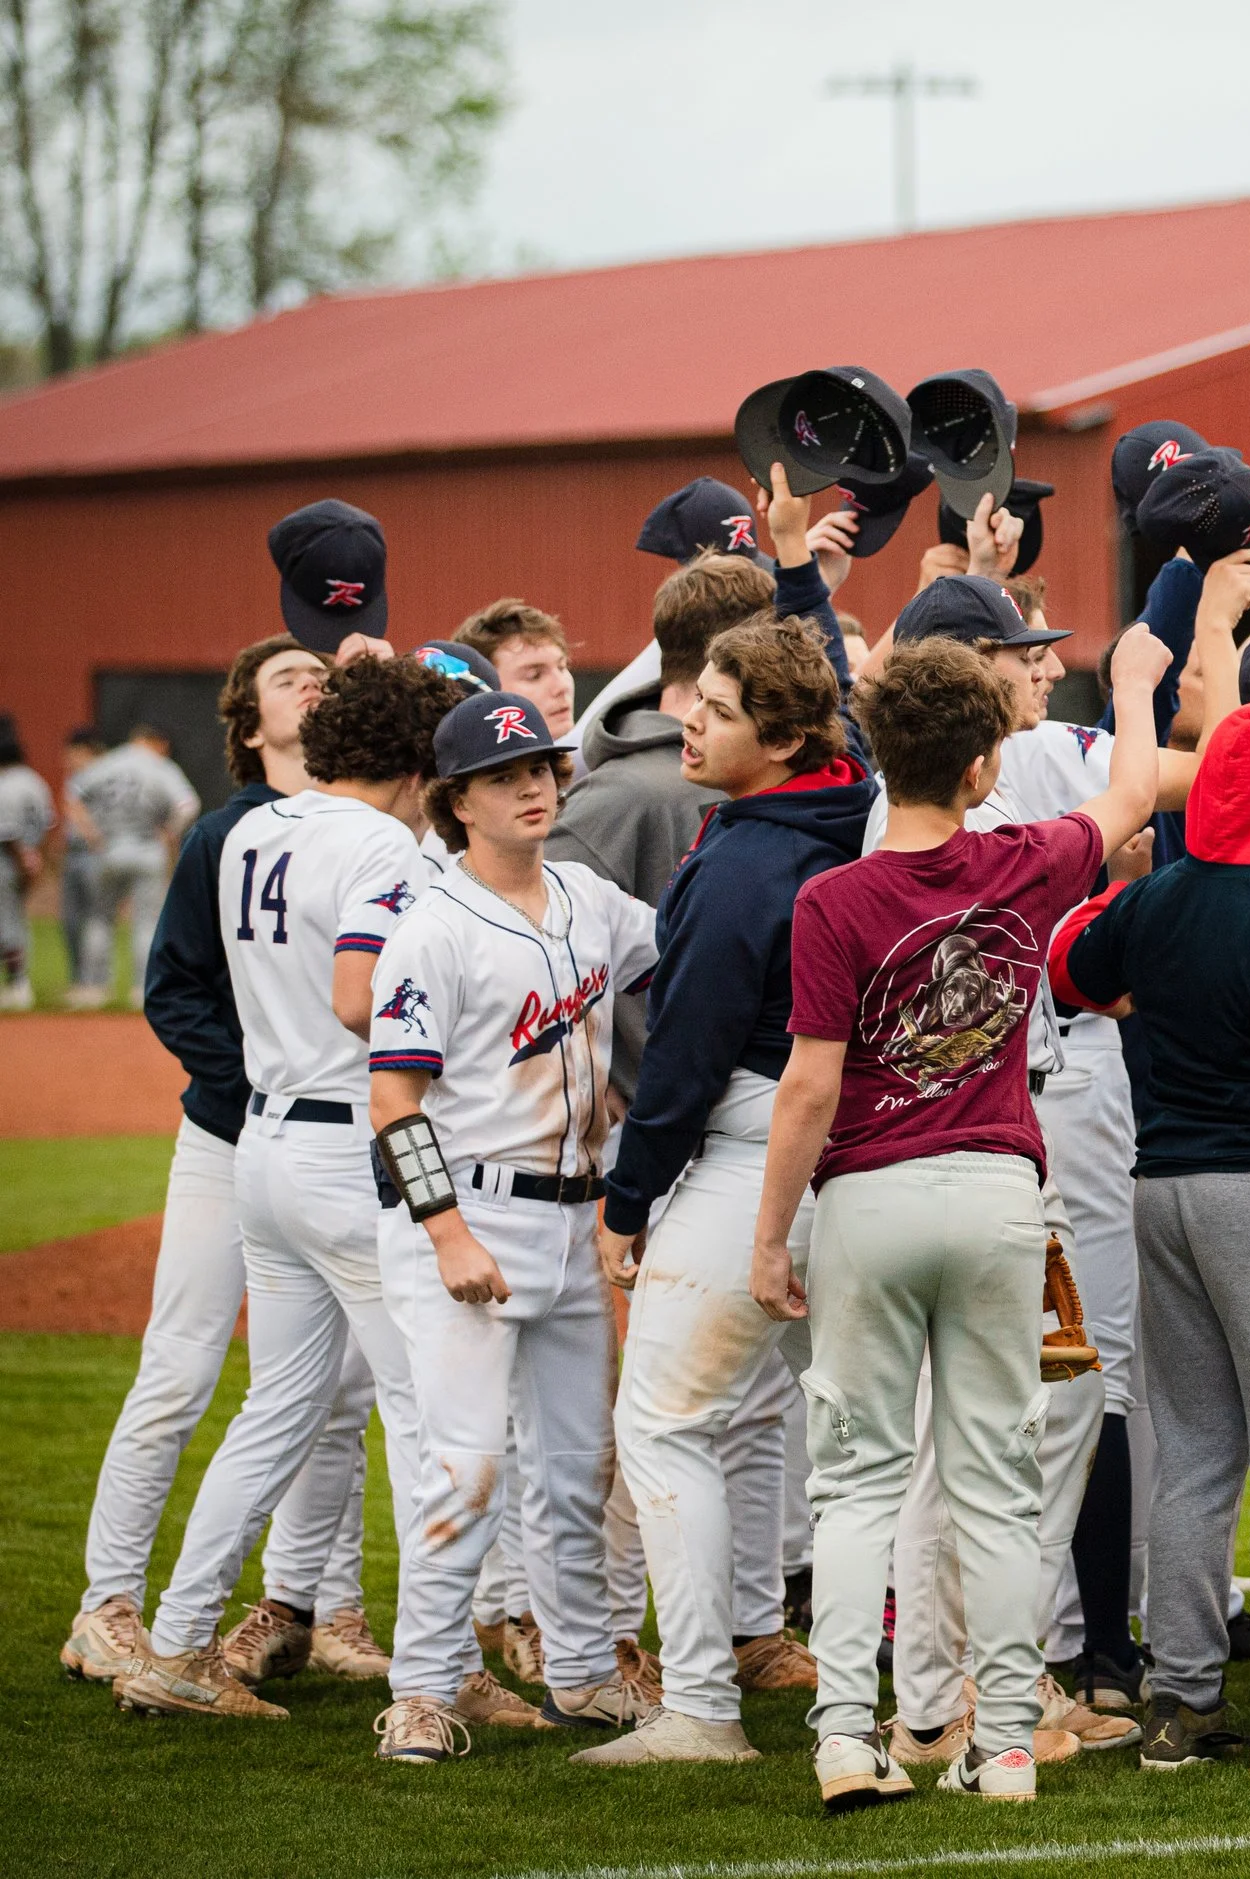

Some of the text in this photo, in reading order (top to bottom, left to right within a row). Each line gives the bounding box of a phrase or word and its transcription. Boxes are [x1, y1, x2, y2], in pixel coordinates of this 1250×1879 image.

[720, 515, 756, 551] R
[323, 579, 365, 607] R
[484, 706, 538, 744] R
[237, 849, 293, 944] 14
